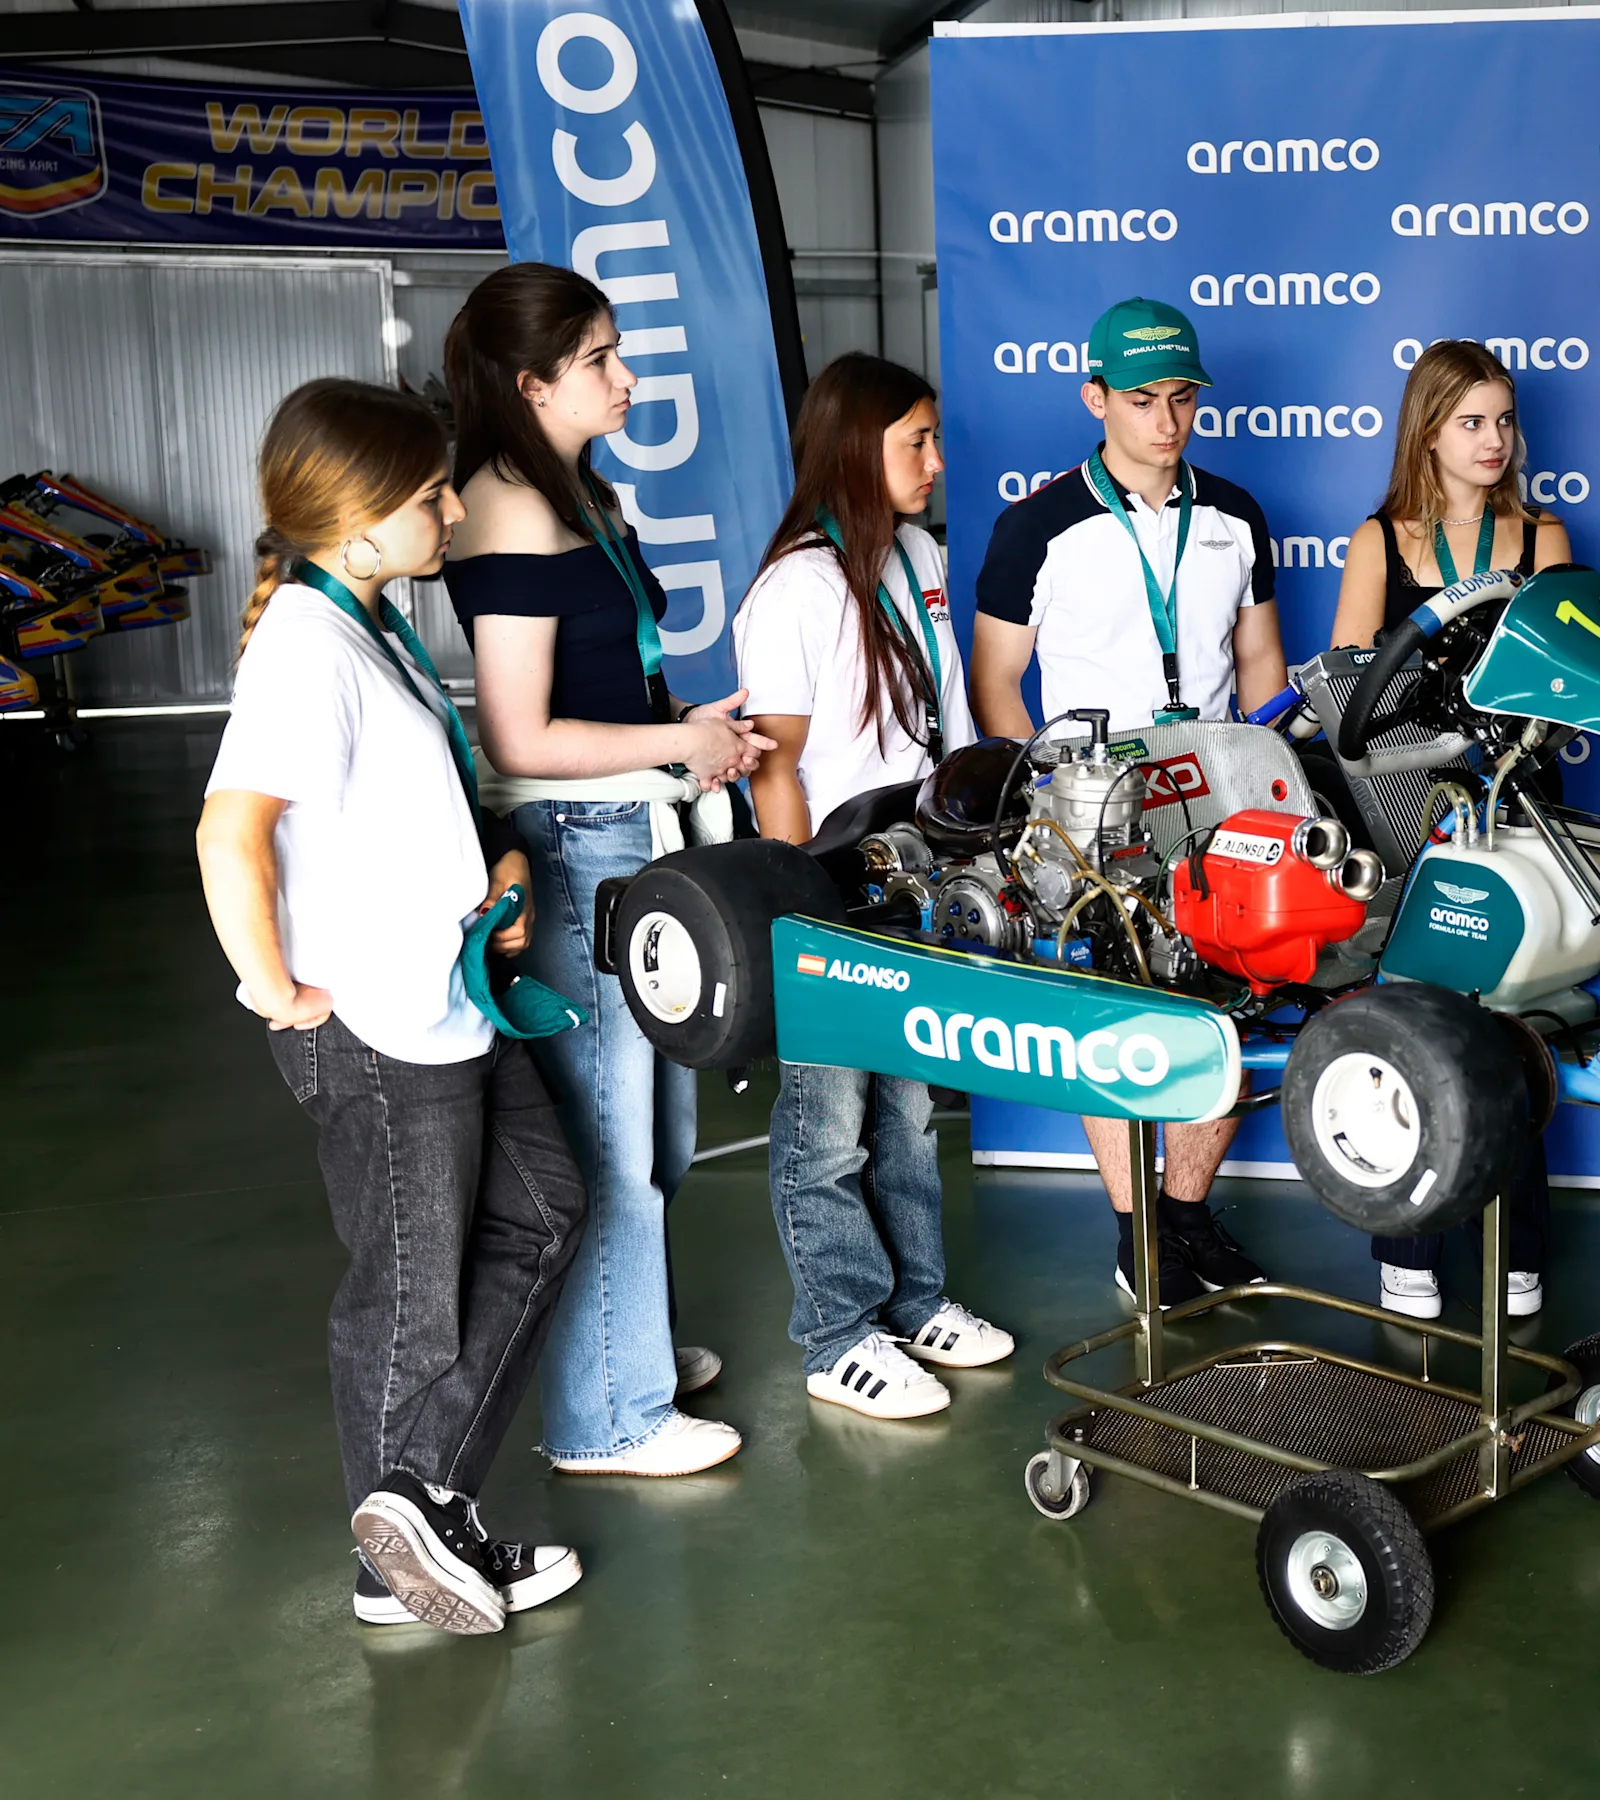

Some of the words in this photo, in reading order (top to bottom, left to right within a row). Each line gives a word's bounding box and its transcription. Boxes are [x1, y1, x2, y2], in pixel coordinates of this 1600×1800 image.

[205, 102, 491, 161] WORLD
[0, 157, 26, 171] CING
[1187, 138, 1380, 174] aramco
[141, 162, 503, 221] CHAMPIO
[989, 208, 1178, 243] aramco
[1391, 201, 1590, 237] aramco
[1189, 271, 1381, 307] aramco
[535, 12, 726, 658] aramco
[1123, 344, 1157, 358] FORMULA
[1174, 344, 1190, 353] TEAM
[993, 341, 1090, 374] ara
[1394, 337, 1590, 371] amco
[1192, 404, 1384, 438] aramco
[1094, 467, 1118, 506] ASTON
[1443, 571, 1503, 604] ALONSO
[1353, 653, 1378, 665] ara
[1110, 742, 1136, 753] CIRCUITO
[1223, 840, 1266, 857] ALONSO
[1428, 922, 1456, 935] FORMULA
[1471, 931, 1488, 941] TEAM
[1430, 907, 1489, 932] aramco
[827, 959, 911, 992] ALONSO
[903, 1006, 1170, 1087] aramco
